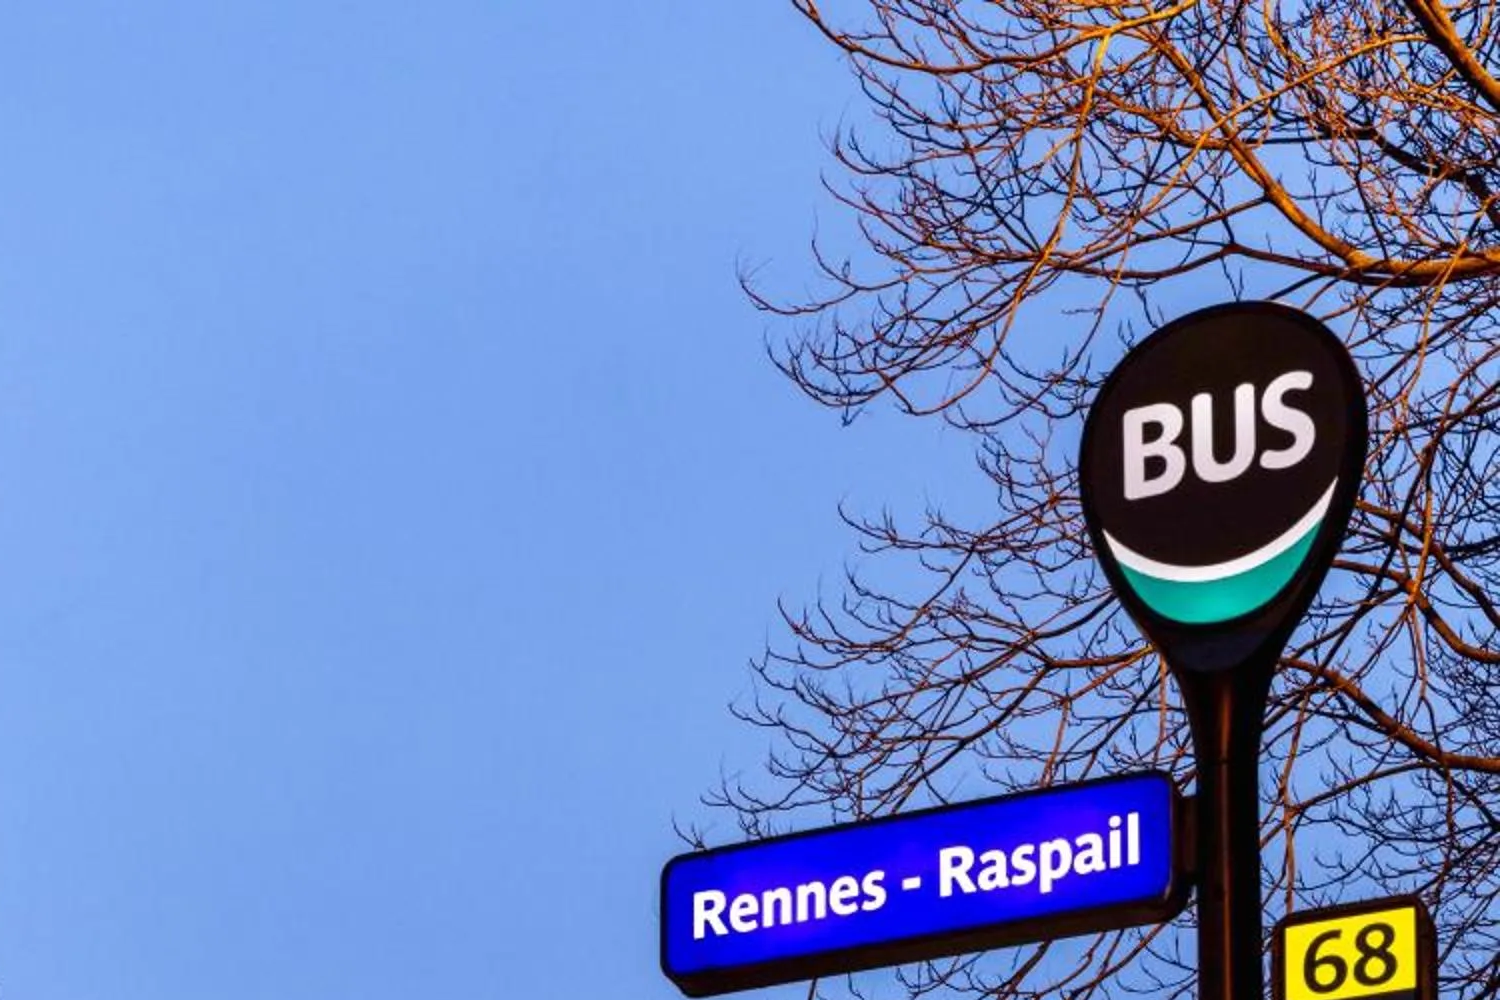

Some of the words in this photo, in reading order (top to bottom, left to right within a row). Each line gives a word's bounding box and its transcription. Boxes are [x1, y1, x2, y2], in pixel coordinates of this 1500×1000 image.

[1123, 370, 1316, 500] BUS
[693, 869, 887, 940] Rennes
[939, 811, 1140, 898] Raspail
[1303, 922, 1398, 995] 68
